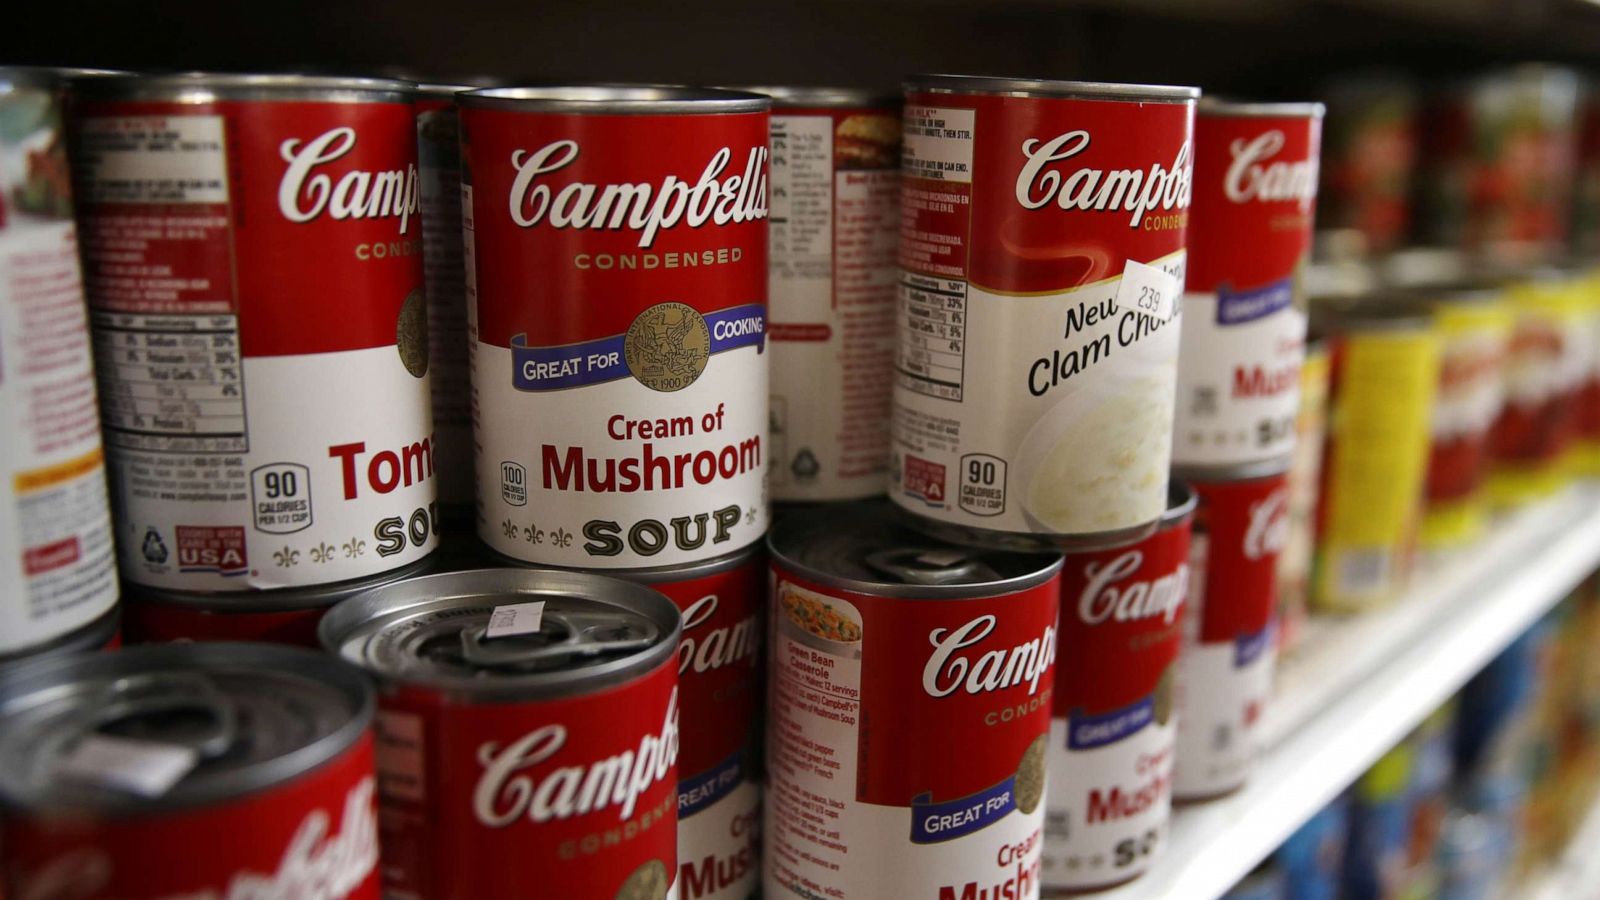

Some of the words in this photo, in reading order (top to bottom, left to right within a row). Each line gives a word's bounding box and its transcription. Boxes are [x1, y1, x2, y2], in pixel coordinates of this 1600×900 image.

[943, 129, 956, 138] THEN
[957, 130, 972, 139] STIR.
[944, 162, 955, 171] CAN
[955, 163, 969, 172] END.
[279, 127, 422, 234] Camp
[509, 140, 767, 247] Campbell's
[574, 247, 743, 270] CONDENSED
[1137, 286, 1161, 313] 239
[713, 316, 763, 341] COOKING
[523, 356, 583, 381] GREAT
[586, 351, 620, 372] FOR
[1028, 333, 1111, 396] Clam
[660, 378, 681, 389] 1900
[607, 414, 694, 441] Cream
[701, 403, 725, 434] of
[503, 465, 522, 485] 100
[541, 434, 762, 494] Mushroom
[968, 460, 995, 485] 90
[265, 471, 297, 498] 90
[963, 485, 1002, 499] CALORIES
[258, 500, 308, 514] CALORIES
[962, 496, 976, 506] PER
[987, 499, 1002, 509] CUP
[258, 514, 276, 525] PER
[291, 512, 309, 523] CUP
[582, 504, 743, 556] SOUP
[180, 548, 243, 564] USA
[787, 642, 810, 660] Green
[810, 652, 835, 668] Bean
[922, 614, 1055, 697] Camp
[790, 656, 830, 680] Casserole
[824, 682, 831, 690] 12
[832, 686, 858, 697] servings
[814, 708, 840, 720] Mushroom
[840, 714, 856, 726] Soup
[473, 685, 679, 828] Campb
[678, 779, 716, 810] REAT
[924, 803, 983, 834] GREAT
[985, 791, 1011, 815] FOR
